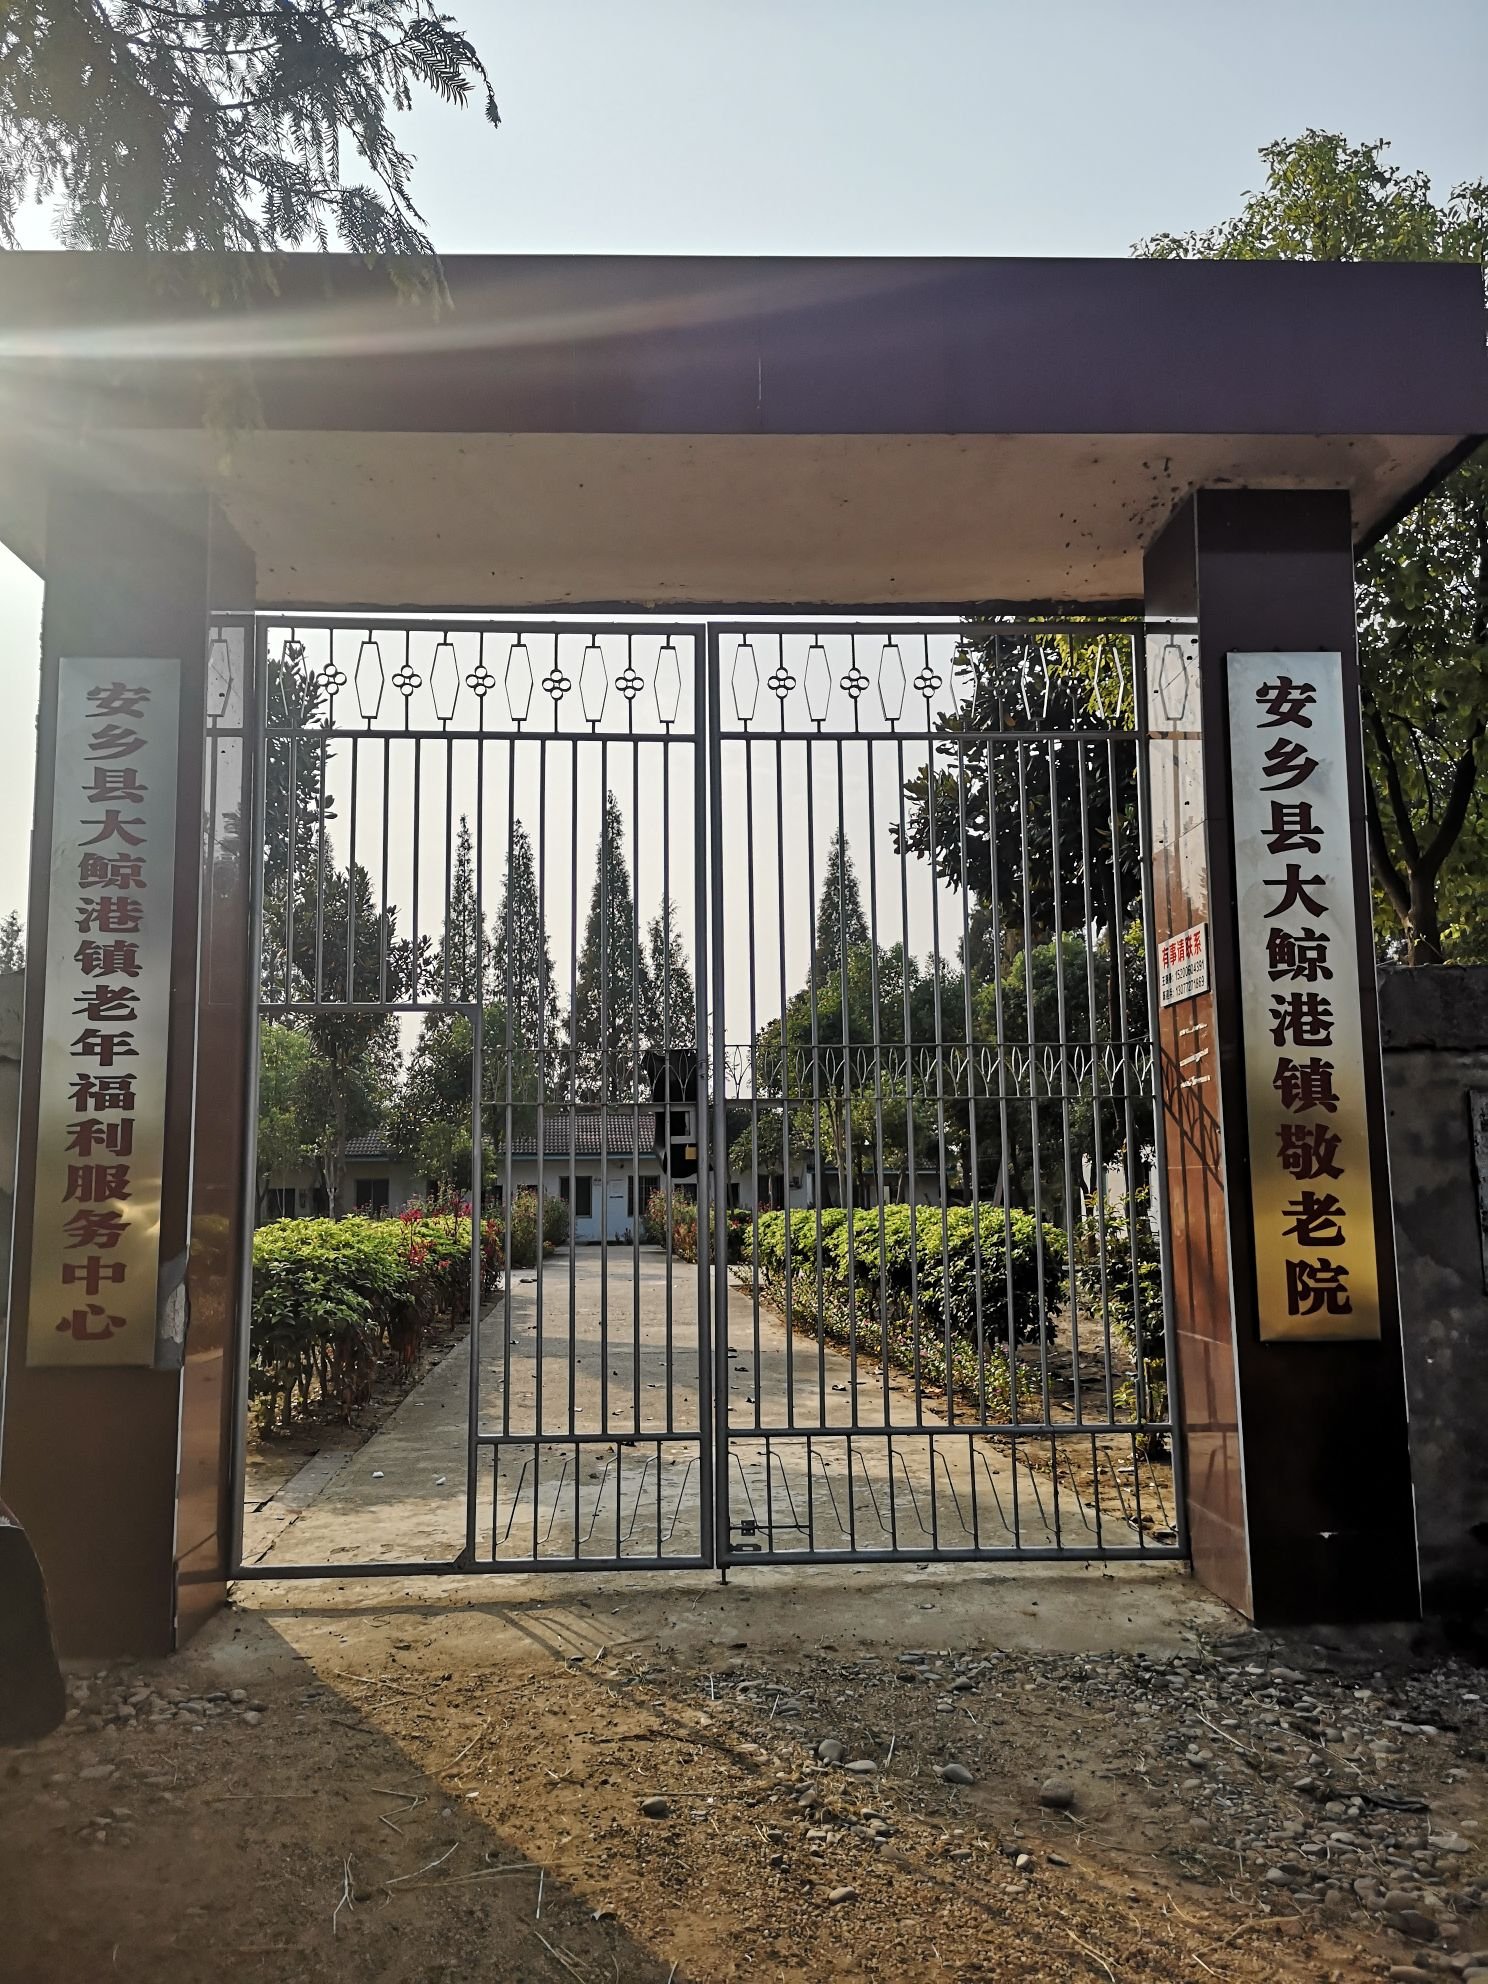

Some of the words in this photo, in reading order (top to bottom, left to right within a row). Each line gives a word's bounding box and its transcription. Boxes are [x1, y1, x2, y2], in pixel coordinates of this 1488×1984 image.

[56, 682, 151, 1341] 安乡县大鲸港镇老年福利服务中心
[1162, 931, 1201, 969] 有事请联系
[1255, 675, 1353, 1316] 安乡县大鲸港镇敬老院
